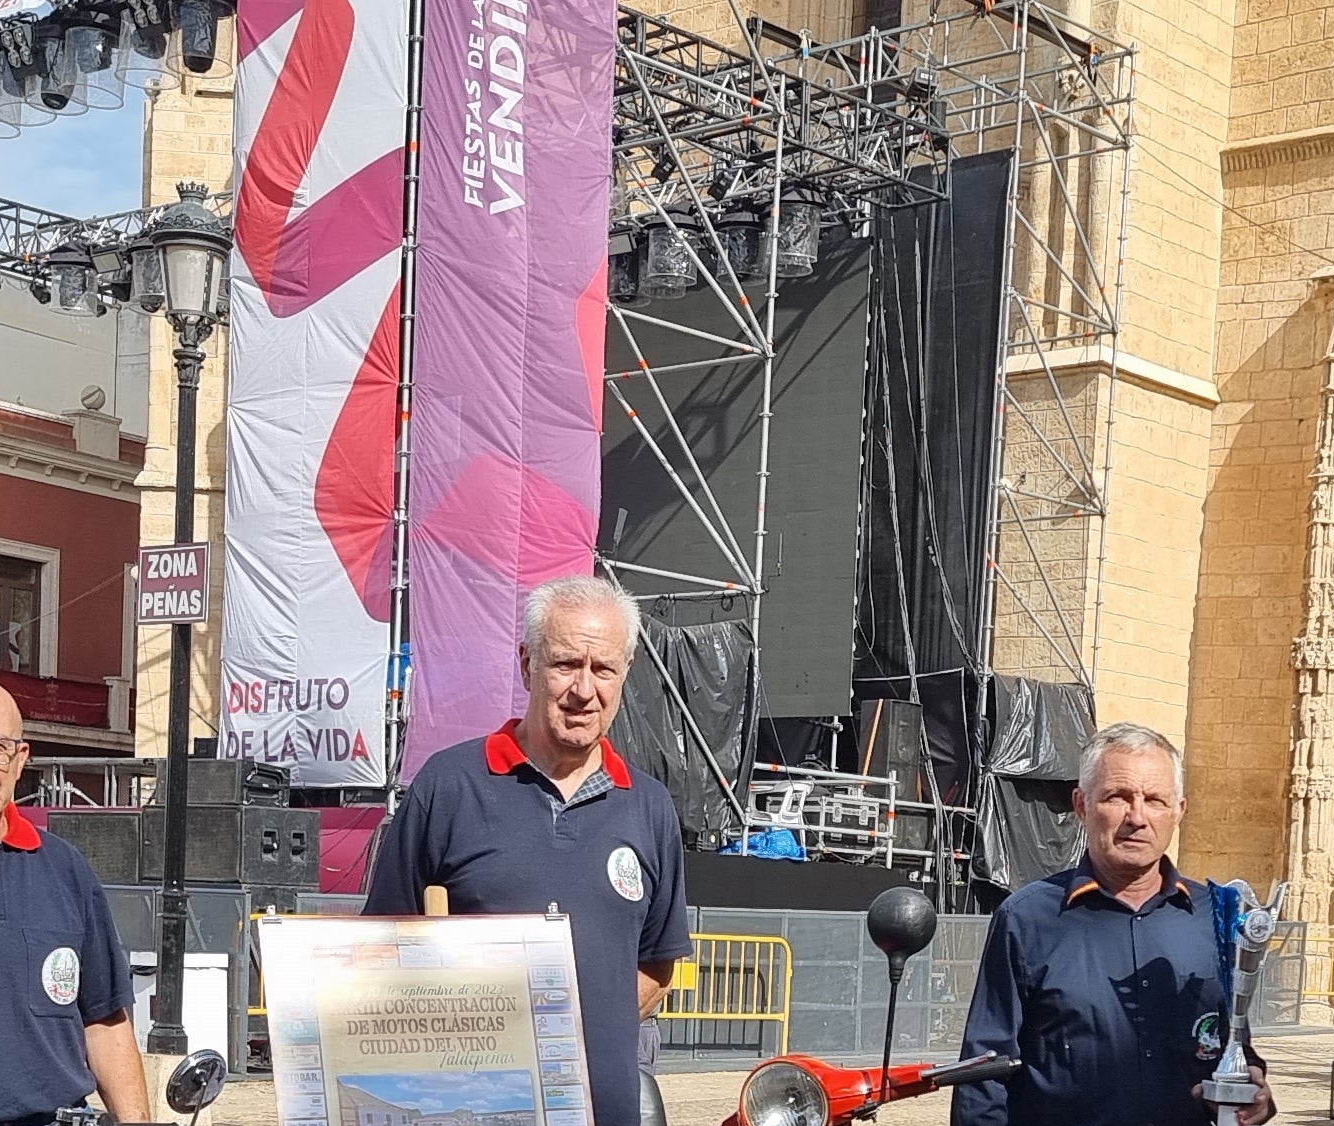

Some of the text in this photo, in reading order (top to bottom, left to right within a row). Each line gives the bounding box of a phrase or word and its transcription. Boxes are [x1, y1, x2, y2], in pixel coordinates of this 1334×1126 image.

[467, 33, 485, 70] DE
[463, 78, 486, 209] FIESTAS
[147, 550, 198, 579] ZONA
[141, 584, 201, 619] PEÑAS
[229, 677, 350, 715] DISFRUTO
[226, 727, 370, 763] DE LA VIDA
[384, 995, 517, 1015] CONCENTRACIÓN
[474, 984, 504, 996] 2023
[347, 1014, 506, 1035] DE MOTOS CLÁSICAS
[359, 1036, 497, 1055] CIUDAD DEL VINO
